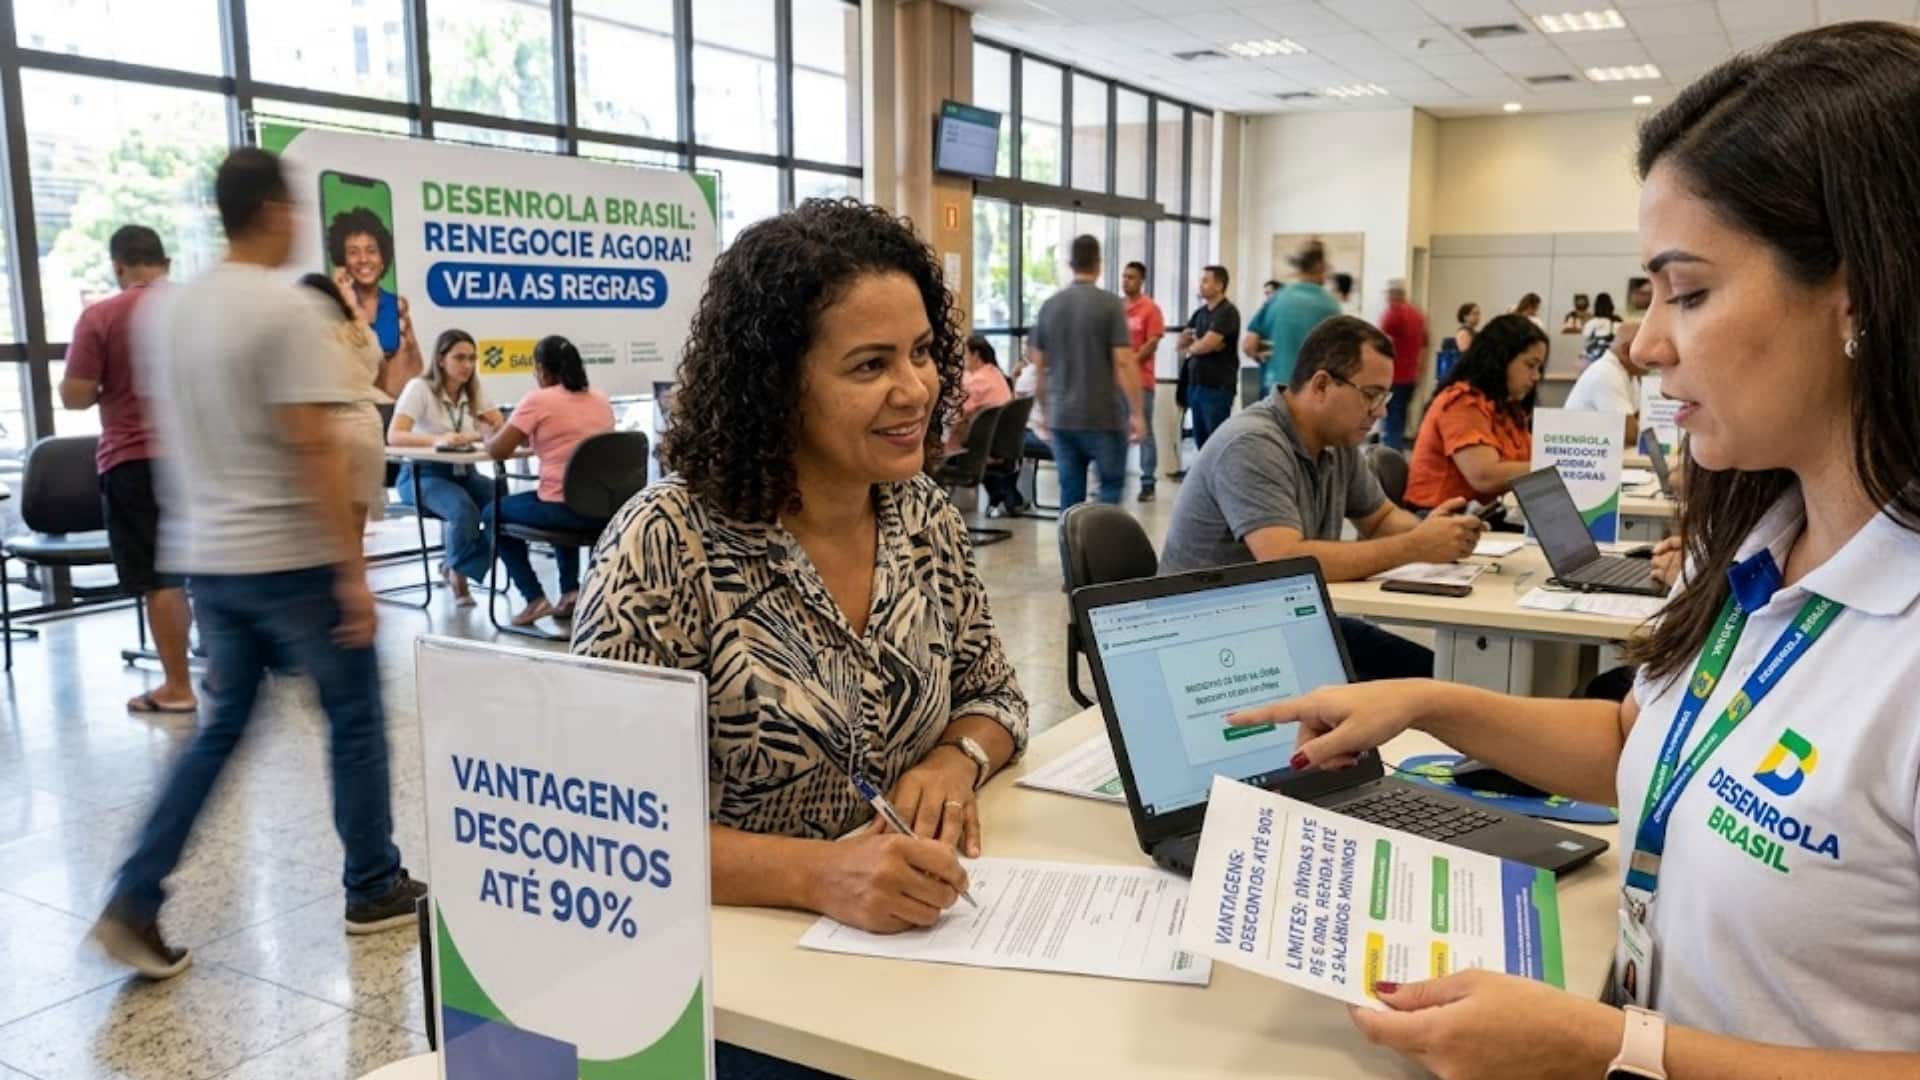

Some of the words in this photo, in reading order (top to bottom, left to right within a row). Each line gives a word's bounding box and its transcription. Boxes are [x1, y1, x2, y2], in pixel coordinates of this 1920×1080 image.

[421, 181, 598, 222] DESENROLA
[605, 198, 696, 229] BRASIL:
[424, 222, 594, 257] RENEGOCIE
[601, 233, 691, 262] AGORA!
[443, 271, 515, 300] VEJA
[519, 273, 555, 301] AS
[561, 274, 656, 302] REGRAS
[451, 755, 669, 831] VANTAGENS:
[1708, 767, 1840, 860] DESENROLA
[454, 807, 672, 889] DESCONTOS
[1707, 805, 1790, 874] BRASIL
[479, 868, 542, 916] ATÉ
[550, 880, 637, 939] 90%
[1215, 850, 1245, 944] VANTAGENS:
[1240, 866, 1265, 952] DESCONTOS
